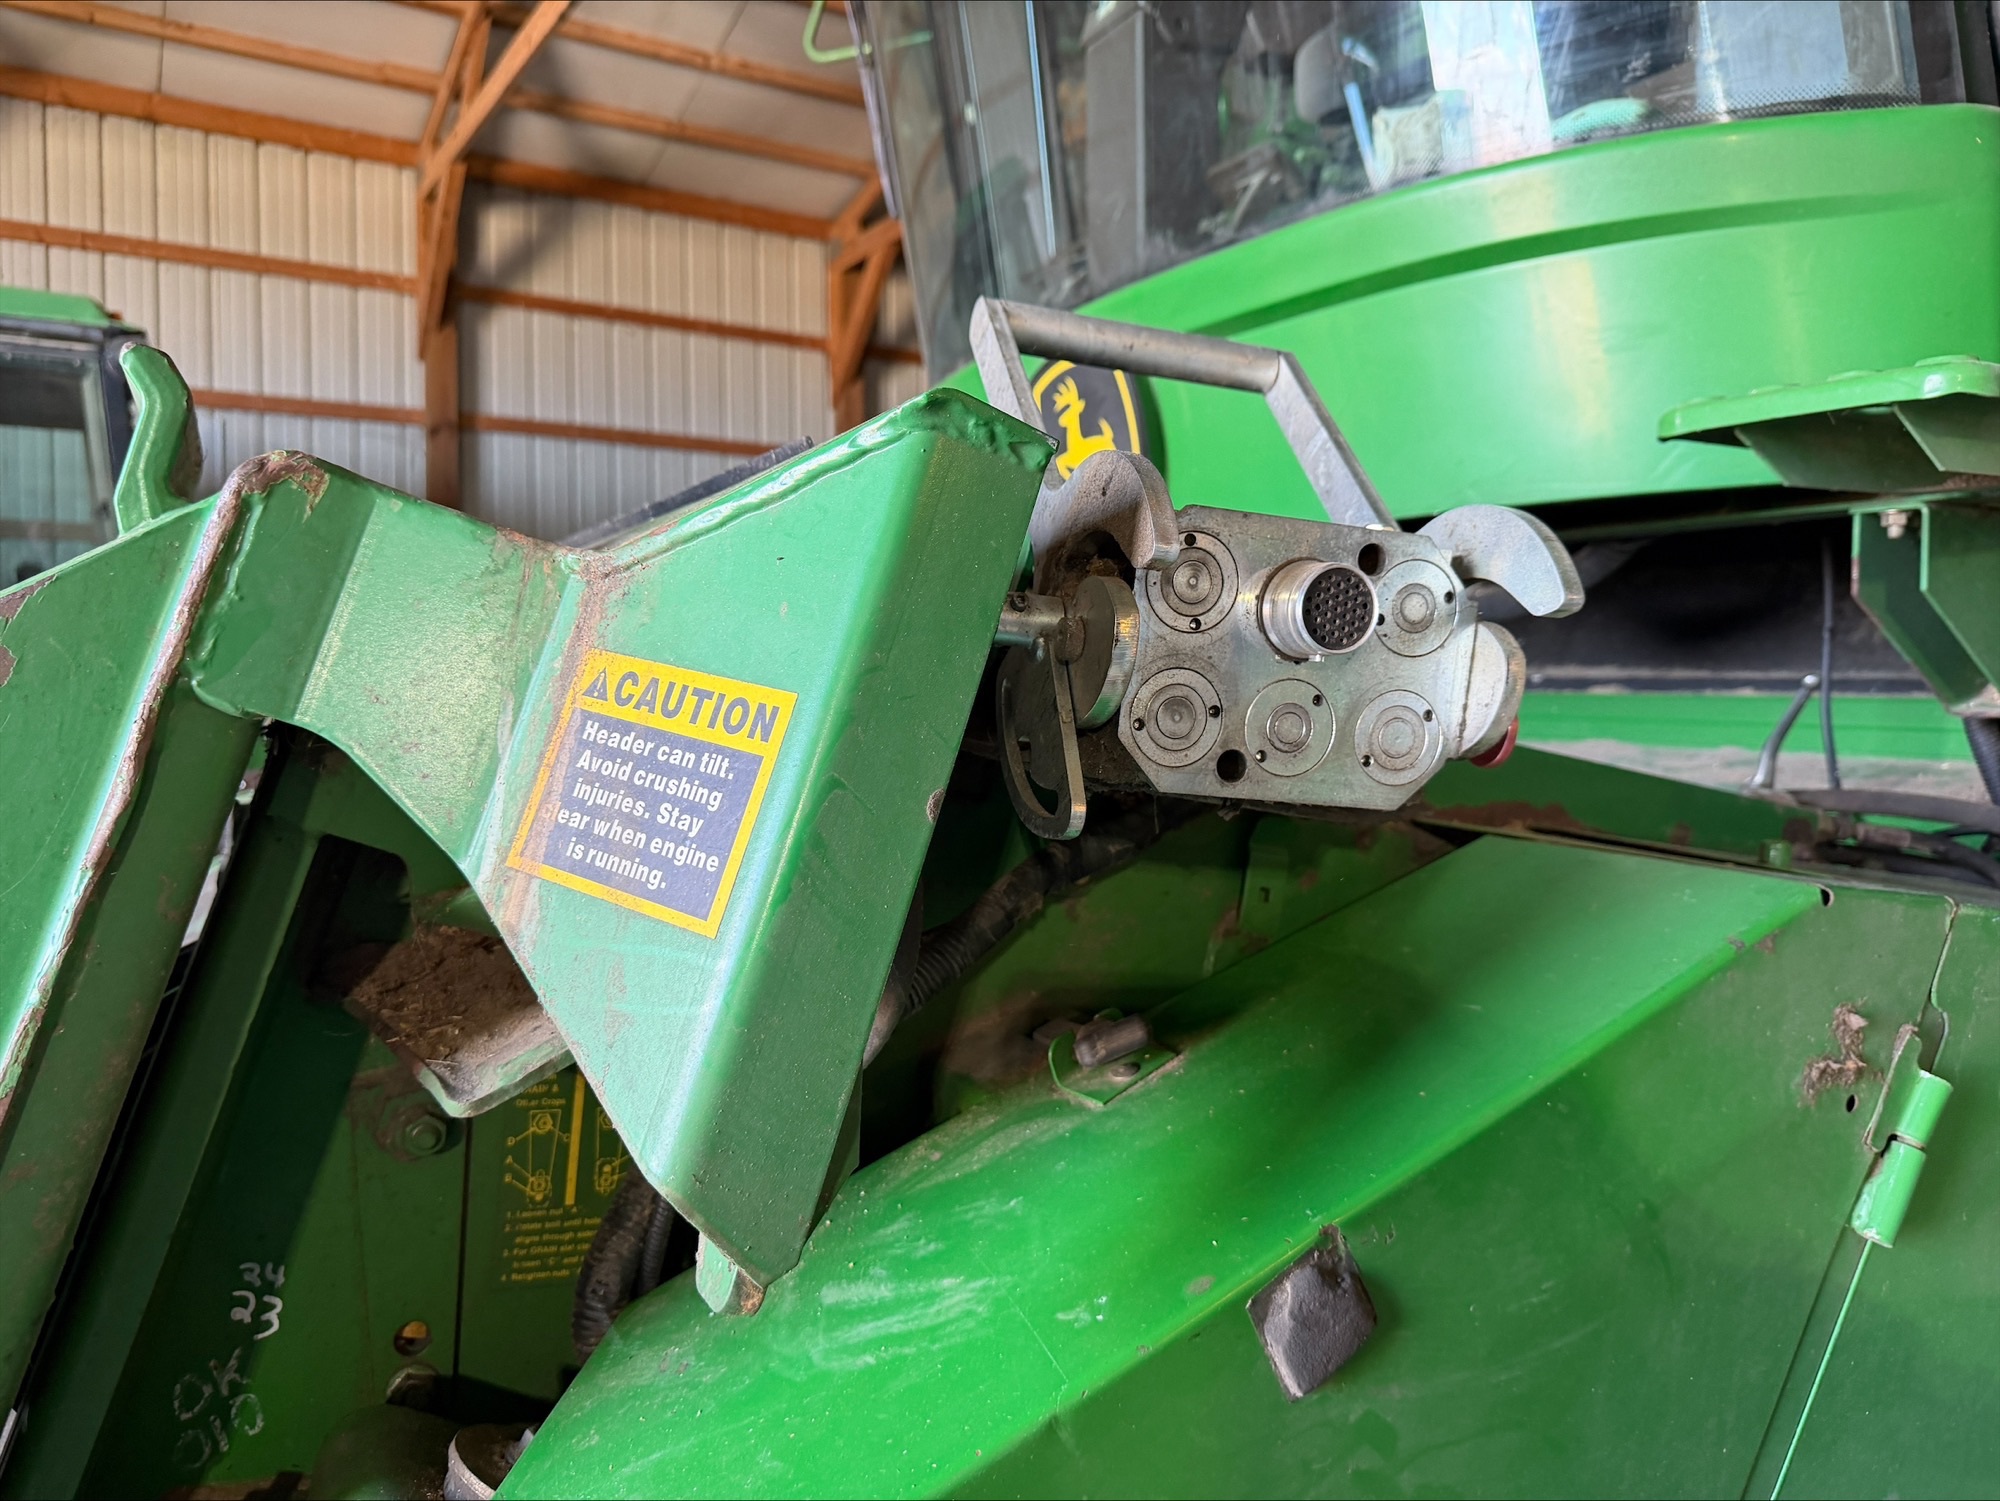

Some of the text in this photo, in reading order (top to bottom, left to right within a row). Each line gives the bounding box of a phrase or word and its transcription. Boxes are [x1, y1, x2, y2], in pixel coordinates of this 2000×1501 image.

[613, 671, 780, 744] CAUTION
[582, 720, 735, 780] Header can tilt.
[572, 778, 705, 838] injuries. Stay
[576, 749, 723, 812] Avoid crushing
[566, 837, 667, 890] is running.
[593, 819, 647, 849] when
[649, 837, 720, 873] engine
[230, 1290, 284, 1340] 23
